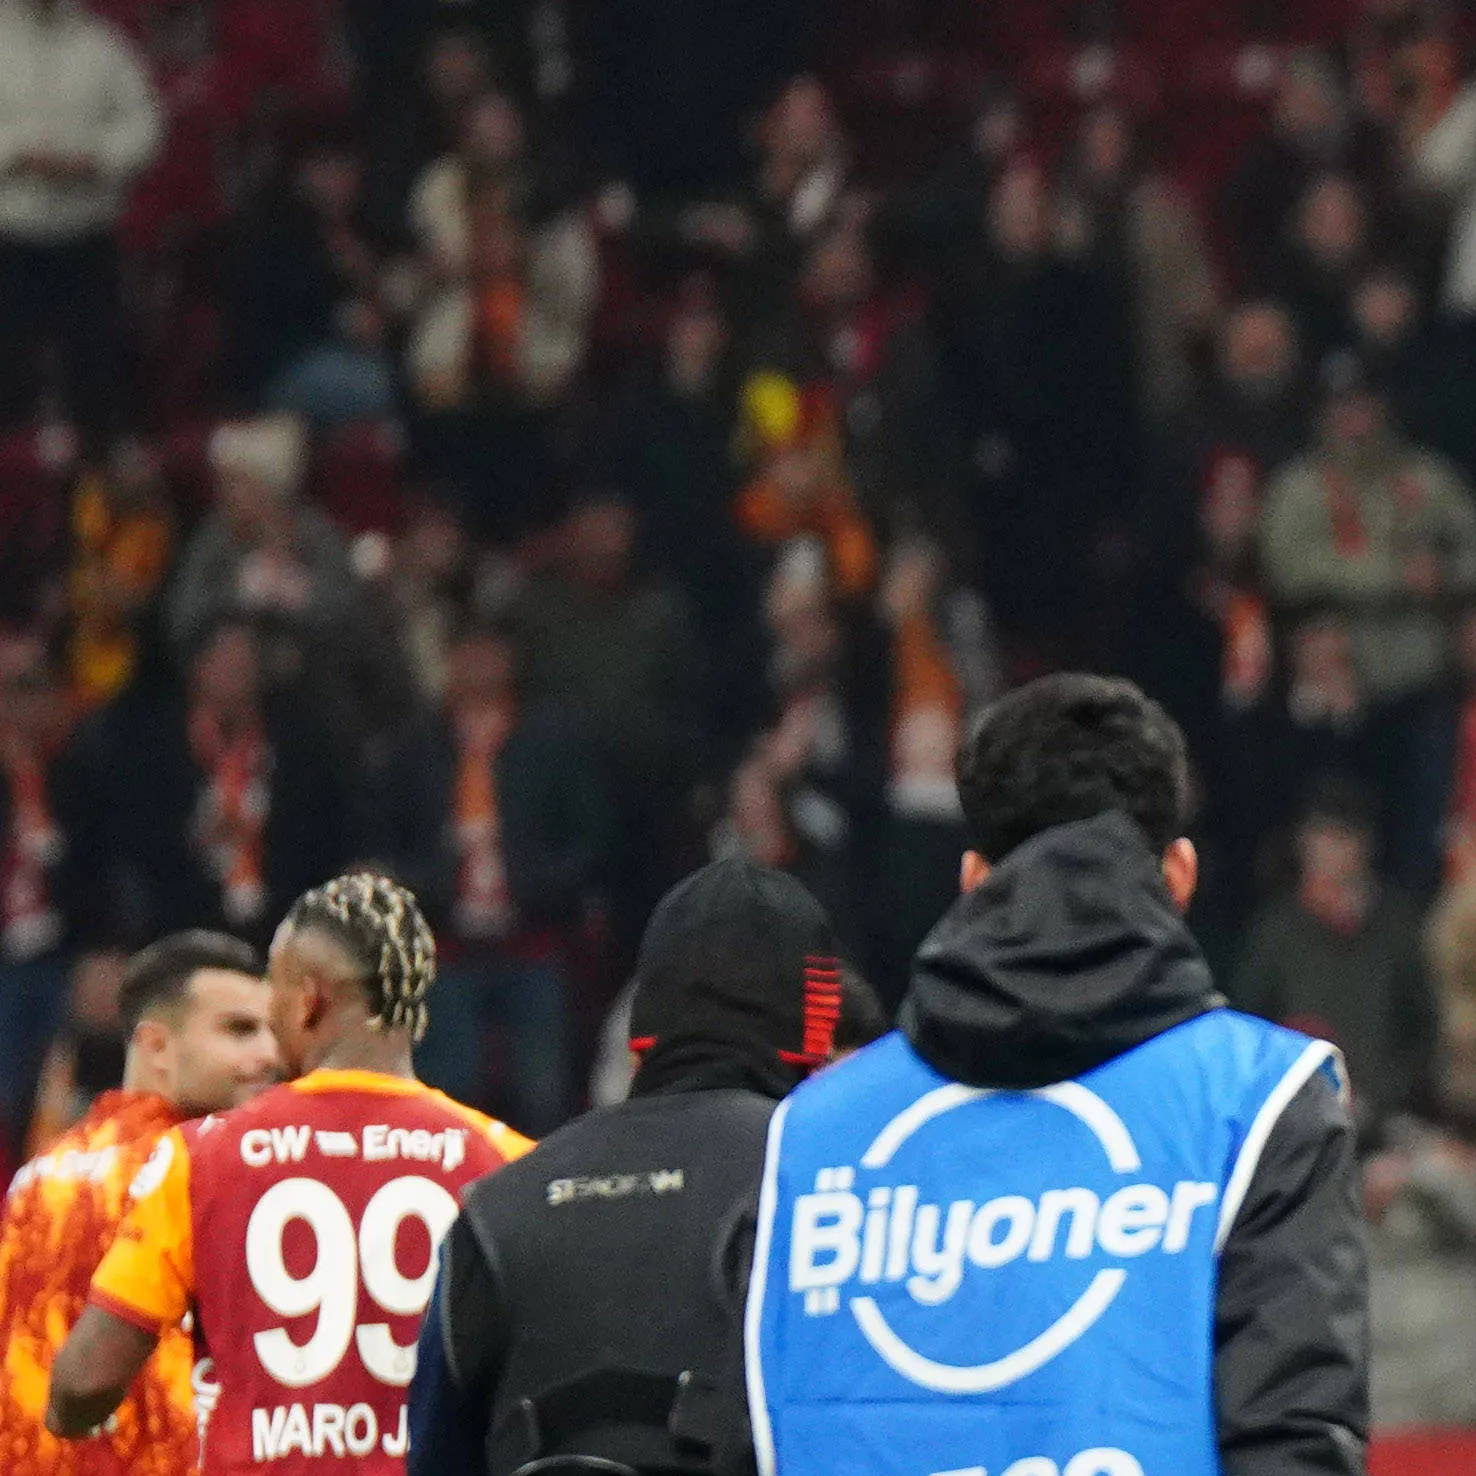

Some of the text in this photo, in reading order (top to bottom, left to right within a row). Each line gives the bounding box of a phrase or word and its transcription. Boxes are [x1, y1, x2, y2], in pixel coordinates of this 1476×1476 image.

[240, 1124, 311, 1168] CW
[246, 1175, 460, 1388] 99
[789, 1165, 1219, 1317] Bilyoner
